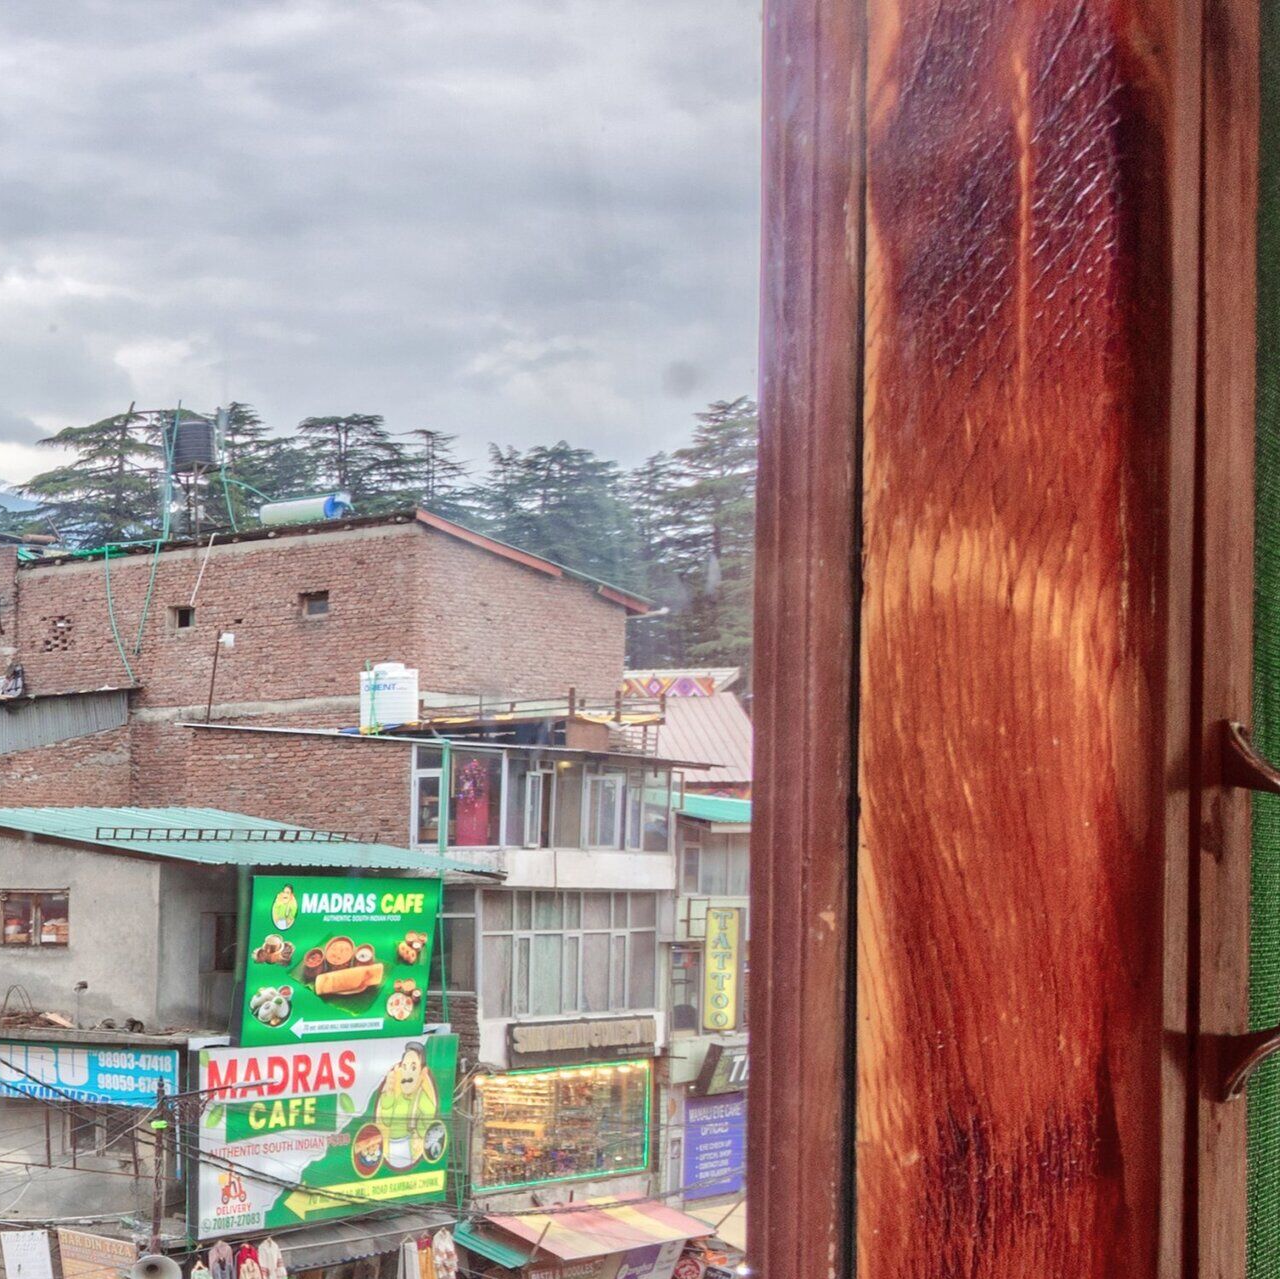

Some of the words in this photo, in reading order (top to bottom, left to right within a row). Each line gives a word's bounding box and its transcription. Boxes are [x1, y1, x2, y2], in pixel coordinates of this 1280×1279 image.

[301, 893, 376, 913] MADRAS
[381, 893, 424, 913] CAFE
[710, 911, 732, 1027] TATTOO
[97, 1073, 171, 1096] 98059-6745
[207, 1050, 356, 1101] MADRAS
[249, 1097, 317, 1130] CAFE
[262, 1142, 293, 1154] SOUTH
[295, 1138, 324, 1151] INDIAN
[216, 1203, 251, 1215] DELIVERY
